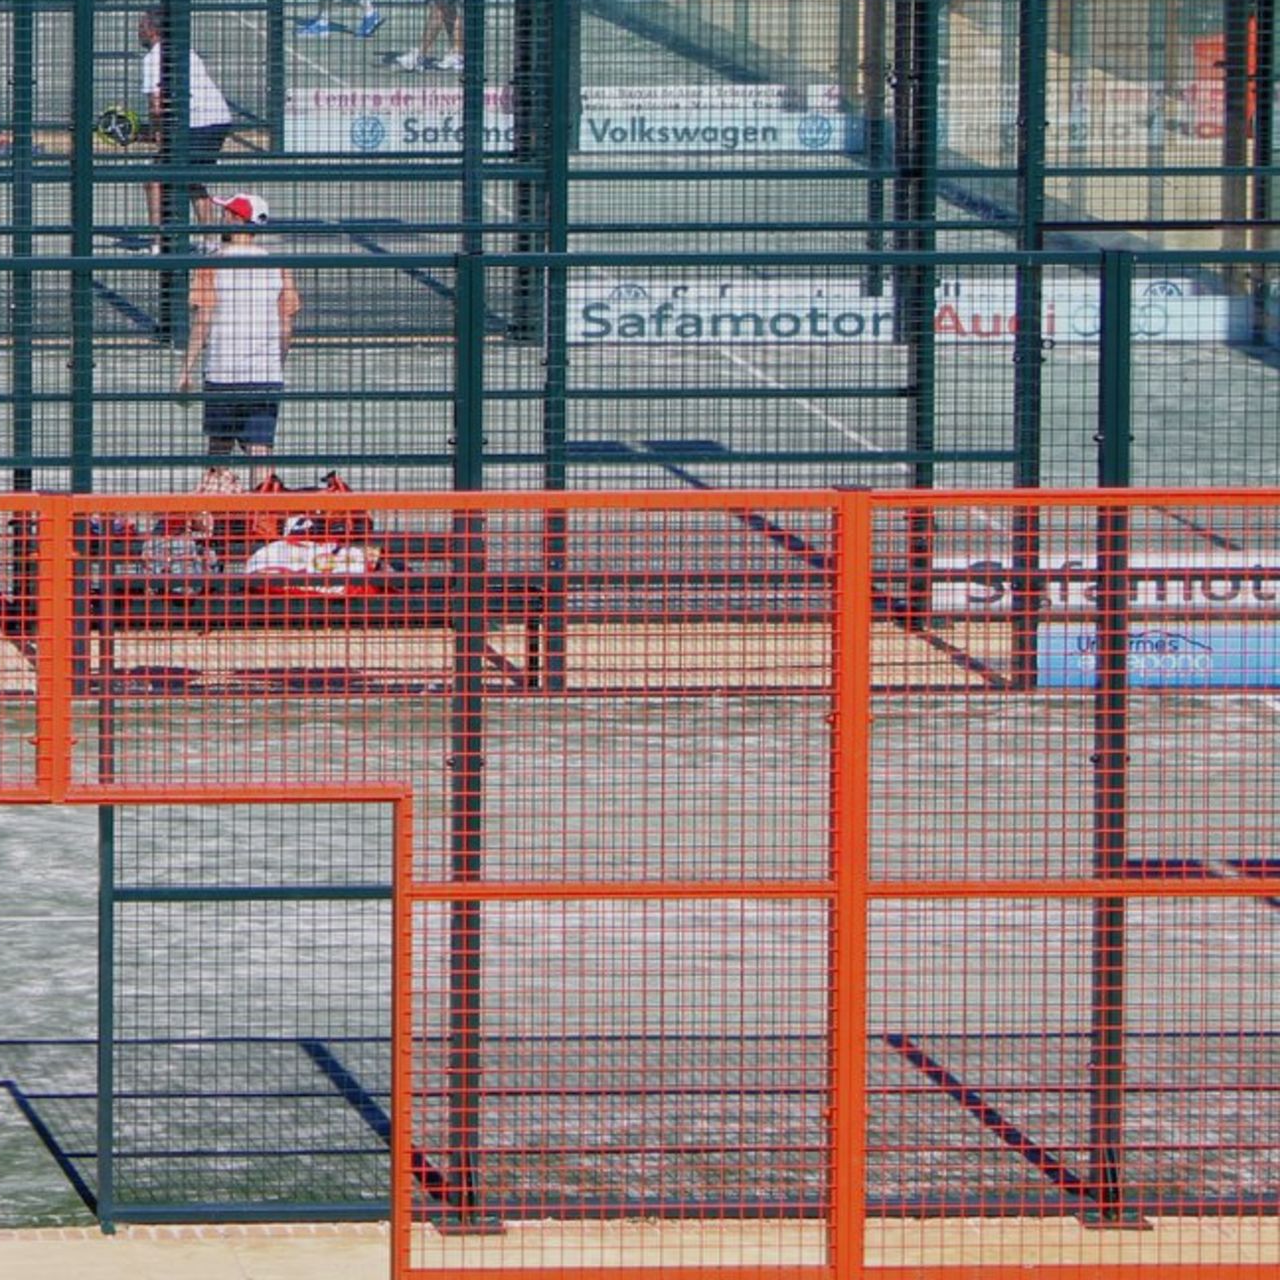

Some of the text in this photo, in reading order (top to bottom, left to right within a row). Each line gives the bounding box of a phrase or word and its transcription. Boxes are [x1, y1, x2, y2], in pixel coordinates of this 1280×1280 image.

[590, 116, 778, 148] Volkswagen
[580, 302, 1055, 339] Safamotor Aui
